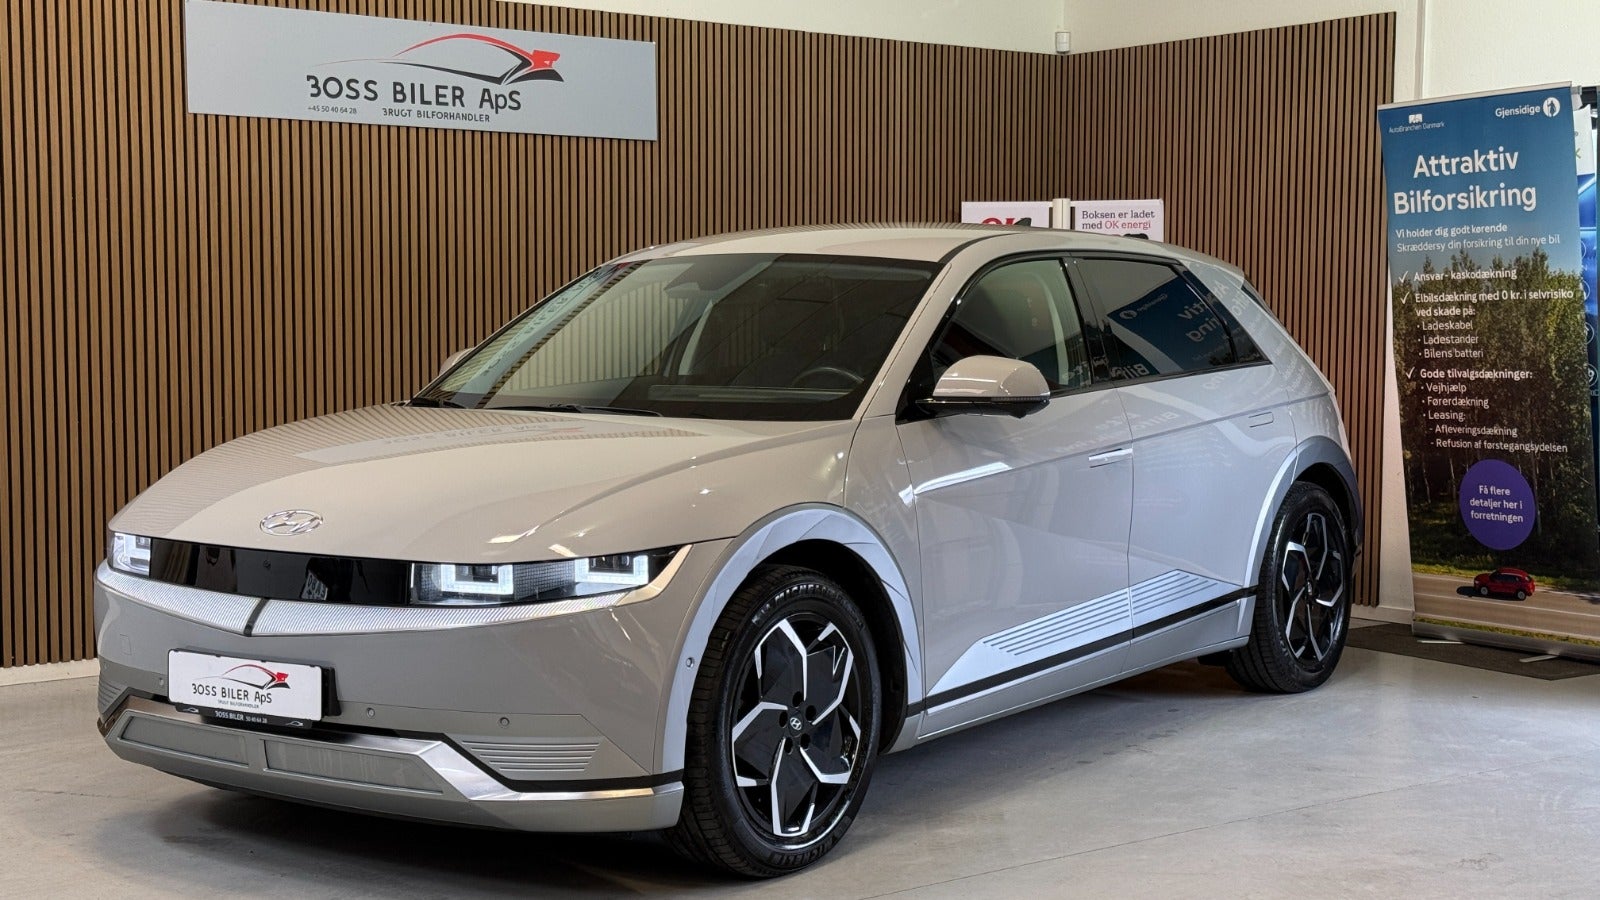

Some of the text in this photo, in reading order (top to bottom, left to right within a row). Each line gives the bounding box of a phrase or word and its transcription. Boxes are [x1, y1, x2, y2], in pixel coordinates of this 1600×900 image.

[392, 83, 466, 108] BILER
[479, 87, 521, 115] ApS
[330, 106, 338, 114] 40
[338, 106, 348, 114] 64
[415, 109, 490, 123] BILFORHANDLER
[1495, 104, 1540, 119] Gjensidige
[1413, 146, 1519, 178] Attraktiv
[1394, 182, 1537, 215] Bilforsikring
[1082, 210, 1155, 219] Boksen er ladet
[1082, 220, 1151, 230] med OK energi
[1396, 223, 1508, 239] Vi holder dig godt kørende
[1396, 234, 1560, 253] Skræddersy din forsikring til din nye bil
[1414, 269, 1517, 281] Ansvar- kaskodækning
[1415, 290, 1573, 304] Elbilsdækning med 0 kr. i selvrisiko
[1416, 306, 1476, 317] ved skade på:
[1422, 321, 1473, 331] Ladeskabel
[1423, 335, 1479, 344] Ladestander
[1423, 349, 1484, 359] Bilens batteri
[1420, 368, 1533, 380] Gode tilvalgsdækninger:
[1426, 383, 1467, 394] Vejhjælp
[1427, 396, 1489, 409] Førerdækning
[1435, 424, 1518, 437] Afleveringsdækning
[1436, 439, 1568, 453] Refusion af førstegangsydelsen
[1479, 484, 1511, 496] Få flere
[1469, 498, 1523, 510] detaljer her i
[1470, 510, 1524, 523] forretningen
[221, 686, 249, 701] BILER
[254, 691, 272, 705] ApS
